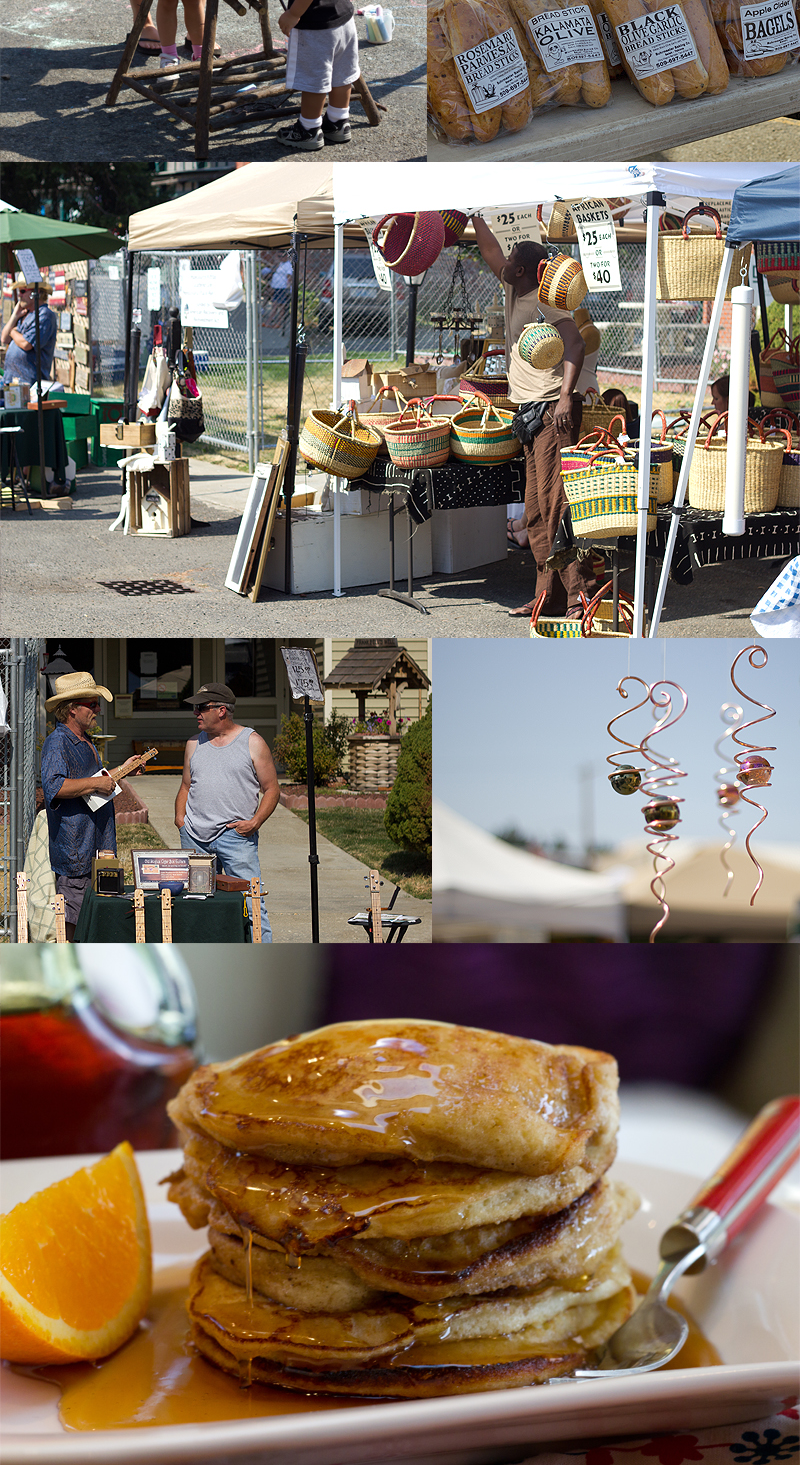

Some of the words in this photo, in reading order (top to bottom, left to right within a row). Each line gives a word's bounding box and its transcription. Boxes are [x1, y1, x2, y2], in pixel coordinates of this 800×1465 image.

[531, 12, 560, 26] BREAD
[562, 6, 587, 17] STICK
[744, 6, 772, 18] Apple
[773, 0, 790, 10] Cider
[534, 16, 592, 38] KALAMATA
[618, 7, 679, 36] BLACK
[621, 28, 649, 45] OLIVE
[649, 15, 682, 35] GARLIC
[744, 11, 795, 41] BAGELS
[539, 27, 595, 46] OLIVE
[625, 37, 654, 53] BREAD
[655, 26, 686, 41] STICKS
[457, 31, 513, 65] ROSEMARY
[461, 41, 516, 75] PARMESAN
[465, 65, 494, 84] BREAD
[497, 212, 516, 225] $25
[576, 210, 609, 224] BASKETS
[582, 230, 598, 246] $25
[592, 269, 611, 283] $40
